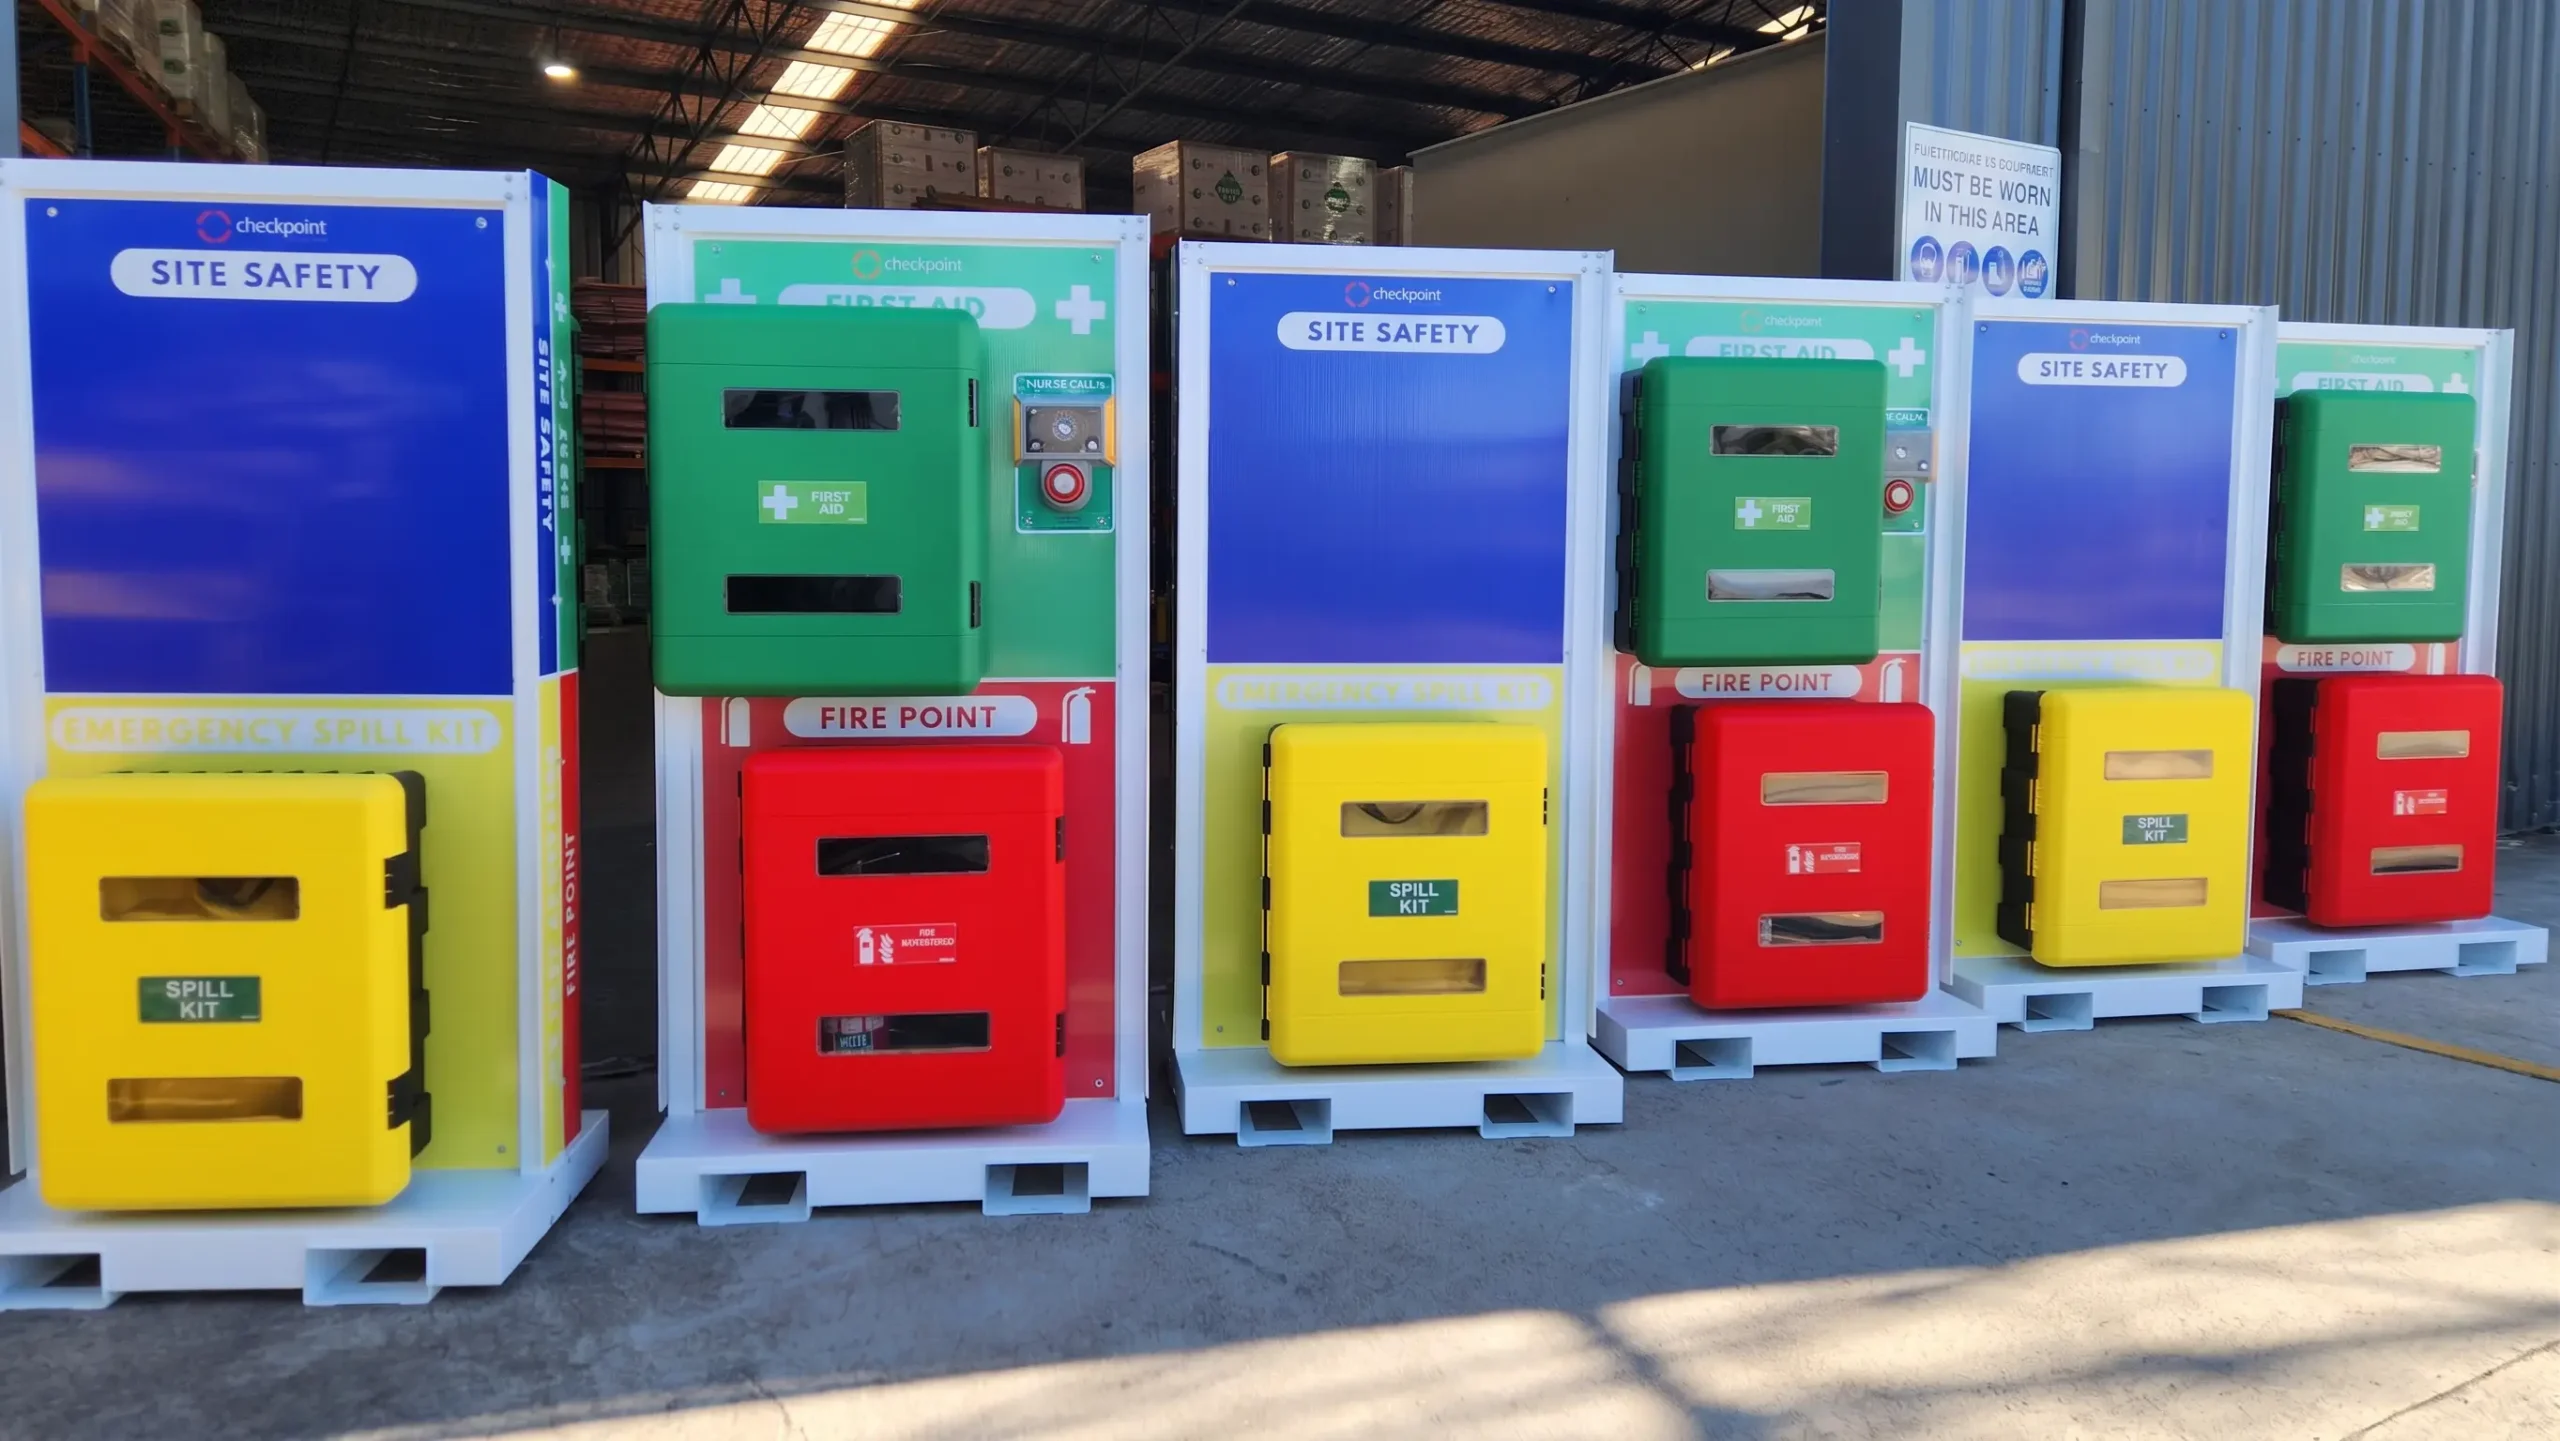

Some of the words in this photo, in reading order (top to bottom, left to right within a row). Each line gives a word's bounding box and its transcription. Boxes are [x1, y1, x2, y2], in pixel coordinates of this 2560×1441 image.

[1914, 165, 1964, 193] MUST
[1970, 175, 1992, 198] BE
[1999, 179, 2051, 207] WORN
[236, 215, 327, 238] checkpoint
[1924, 200, 1942, 222] IN
[1948, 204, 1987, 229] THIS
[1992, 211, 2039, 236] AREA
[151, 259, 227, 287] SITE
[243, 263, 381, 290] SAFETY
[884, 256, 962, 275] checkpoint
[1373, 286, 1442, 304] checkpoint
[1307, 321, 1364, 342] SITE
[1376, 323, 1480, 344] SAFETY
[538, 338, 550, 404] SITE
[2040, 361, 2083, 377] SITE
[2091, 362, 2168, 379] SAFETY
[1026, 379, 1067, 389] NURSE
[541, 418, 554, 531] SAFETY
[811, 491, 851, 503] FIRST
[819, 503, 844, 515] AID
[1772, 504, 1800, 514] FIRST
[1776, 514, 1795, 523] AID
[2297, 652, 2333, 667] FIRE
[2340, 651, 2394, 666] POINT
[1702, 674, 1750, 692] FIRE
[1760, 673, 1832, 691] POINT
[1226, 682, 1400, 704] EMERGENCY
[1413, 682, 1484, 703] SPILL
[1497, 682, 1541, 703] KIT
[820, 706, 887, 729] FIRE
[900, 705, 997, 729] POINT
[62, 718, 299, 745] EMERGENCY
[315, 719, 409, 746] SPILL
[427, 719, 489, 746] KIT
[2137, 817, 2174, 829] SPILL
[2145, 829, 2166, 841] KIT
[564, 833, 577, 921] POINT
[1389, 882, 1439, 898] SPILL
[1399, 898, 1429, 914] KIT
[565, 931, 578, 996] FIRE
[165, 980, 234, 999] SPILL
[180, 1001, 220, 1020] KIT
